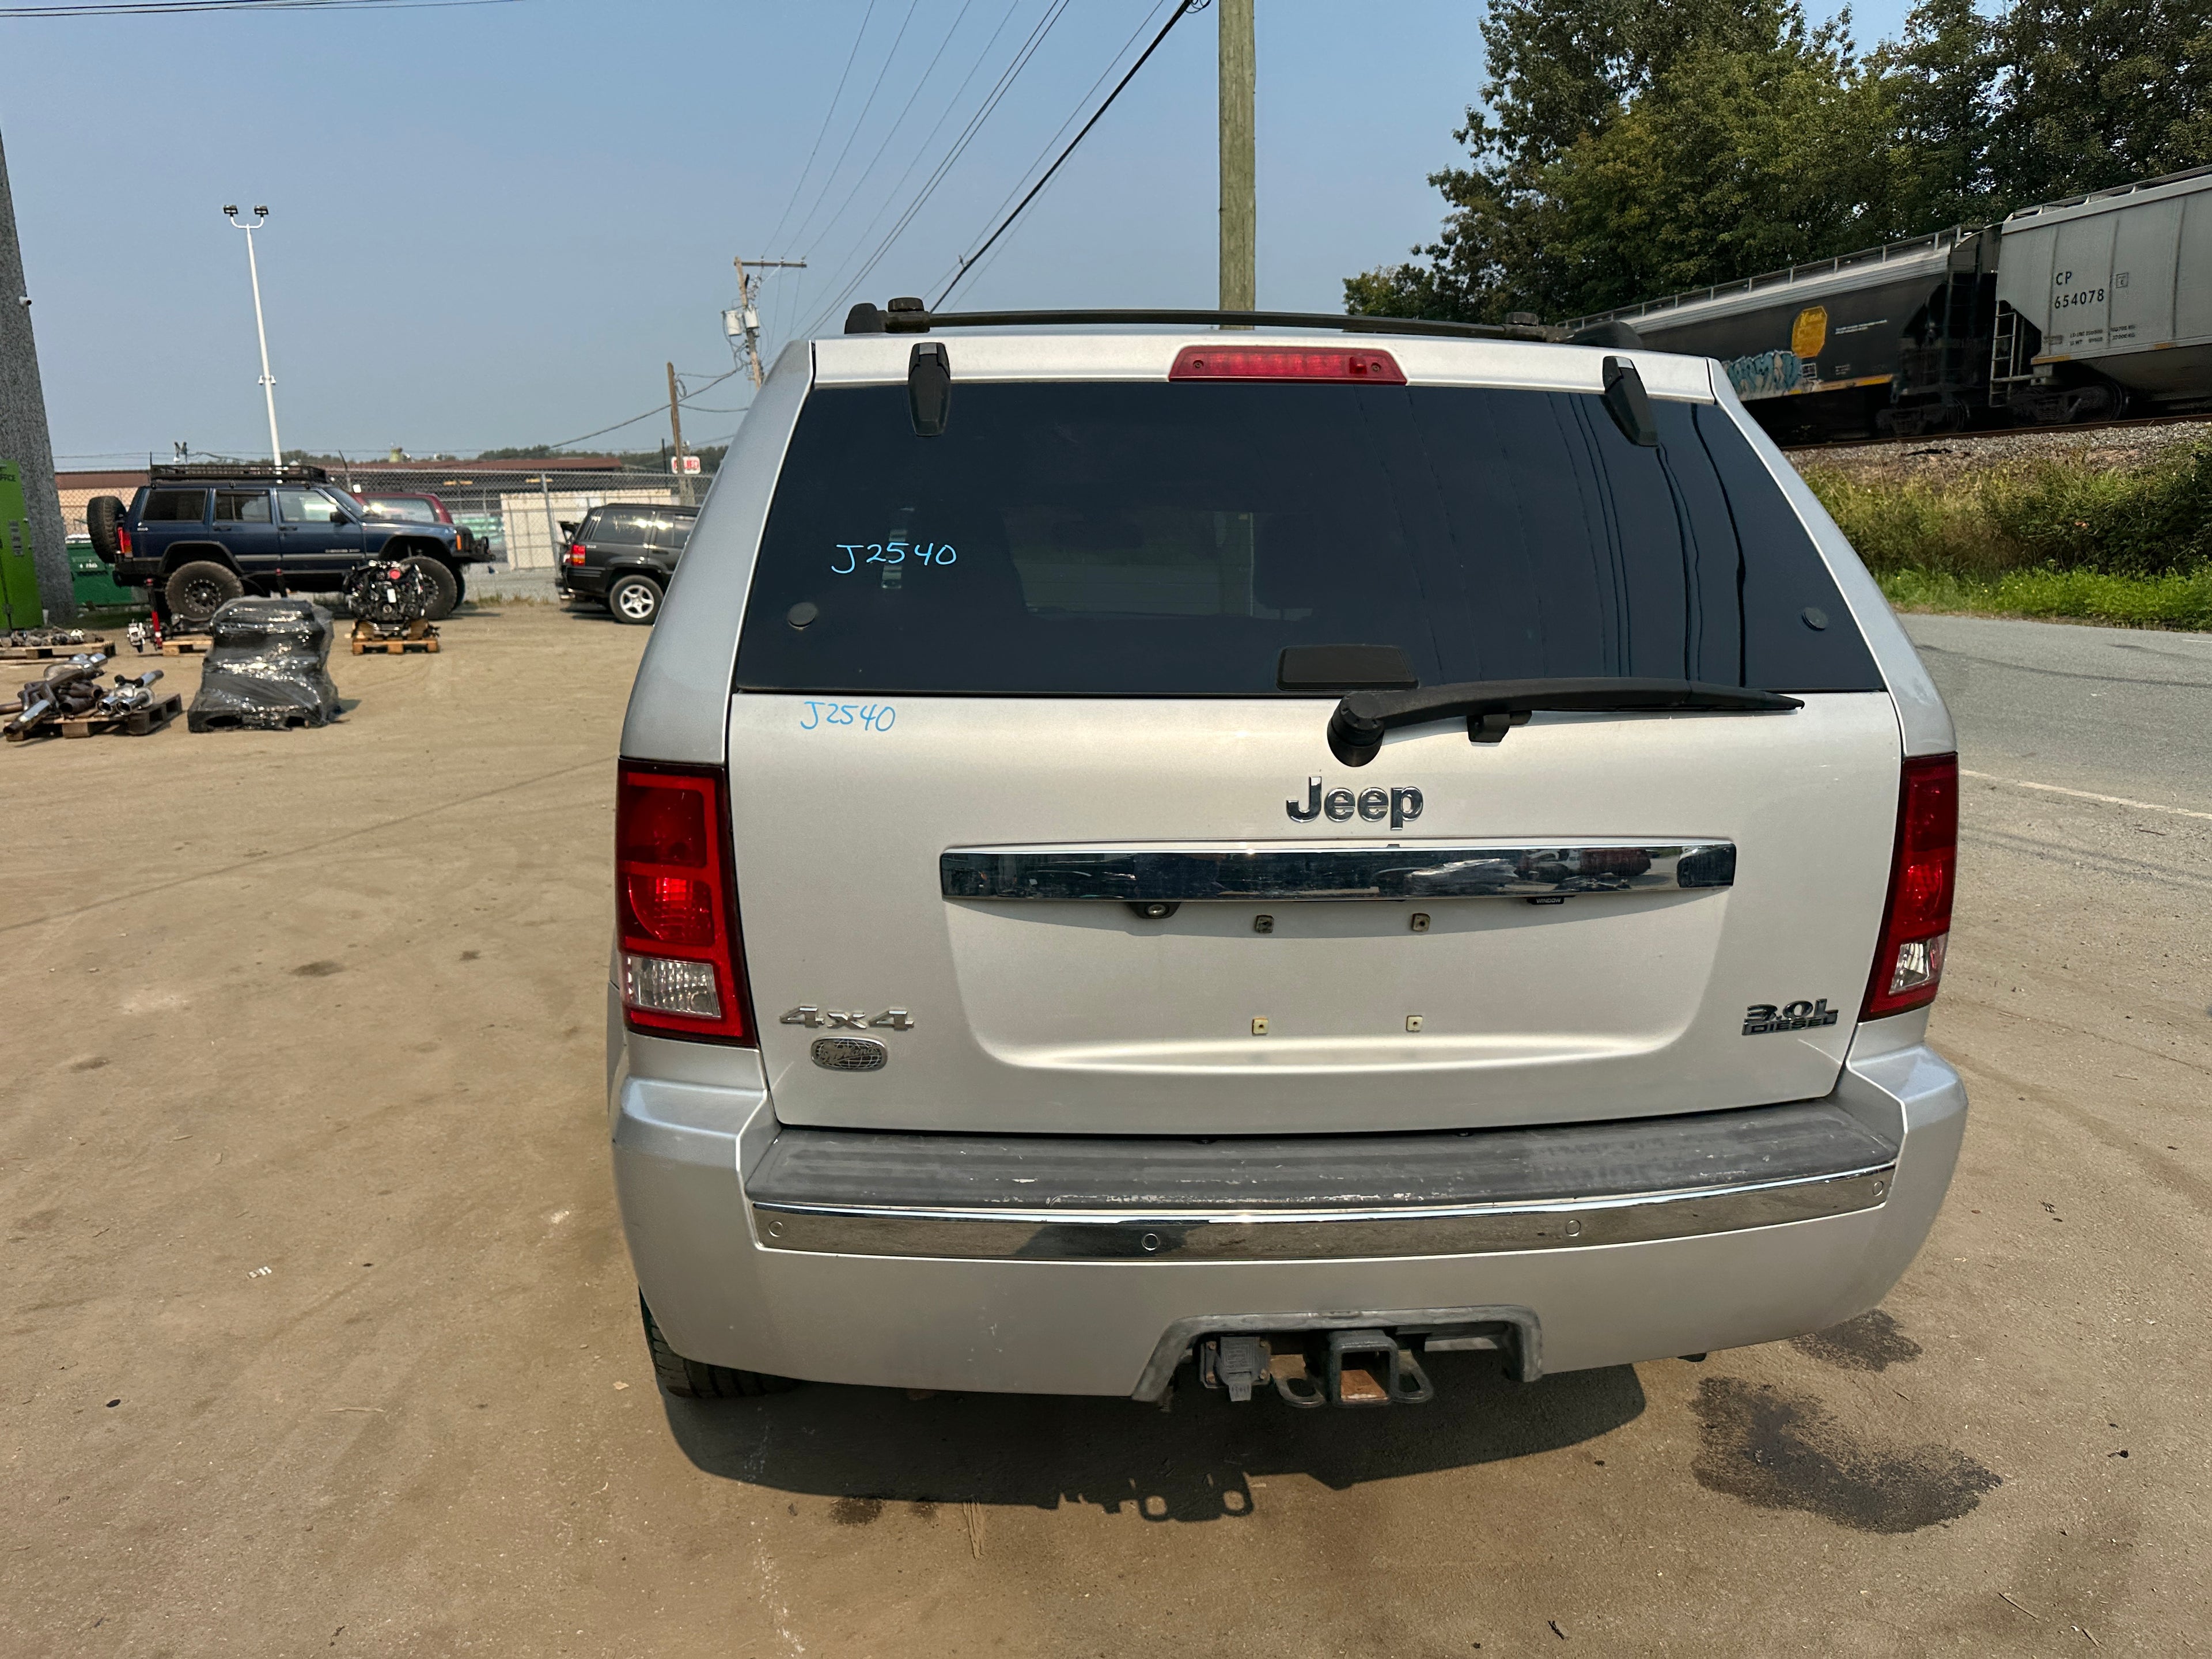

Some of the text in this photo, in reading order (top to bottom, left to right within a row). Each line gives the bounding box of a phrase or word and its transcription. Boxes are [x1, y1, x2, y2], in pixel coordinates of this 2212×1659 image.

[2056, 271, 2072, 286] CP
[2055, 289, 2104, 309] 654078
[831, 542, 957, 574] J2540
[800, 701, 896, 732] J2540
[1286, 776, 1424, 831] Jeep
[779, 1005, 915, 1031] 4x4
[1744, 998, 1839, 1023] 3.0L
[1749, 1016, 1837, 1034] DIESEL
